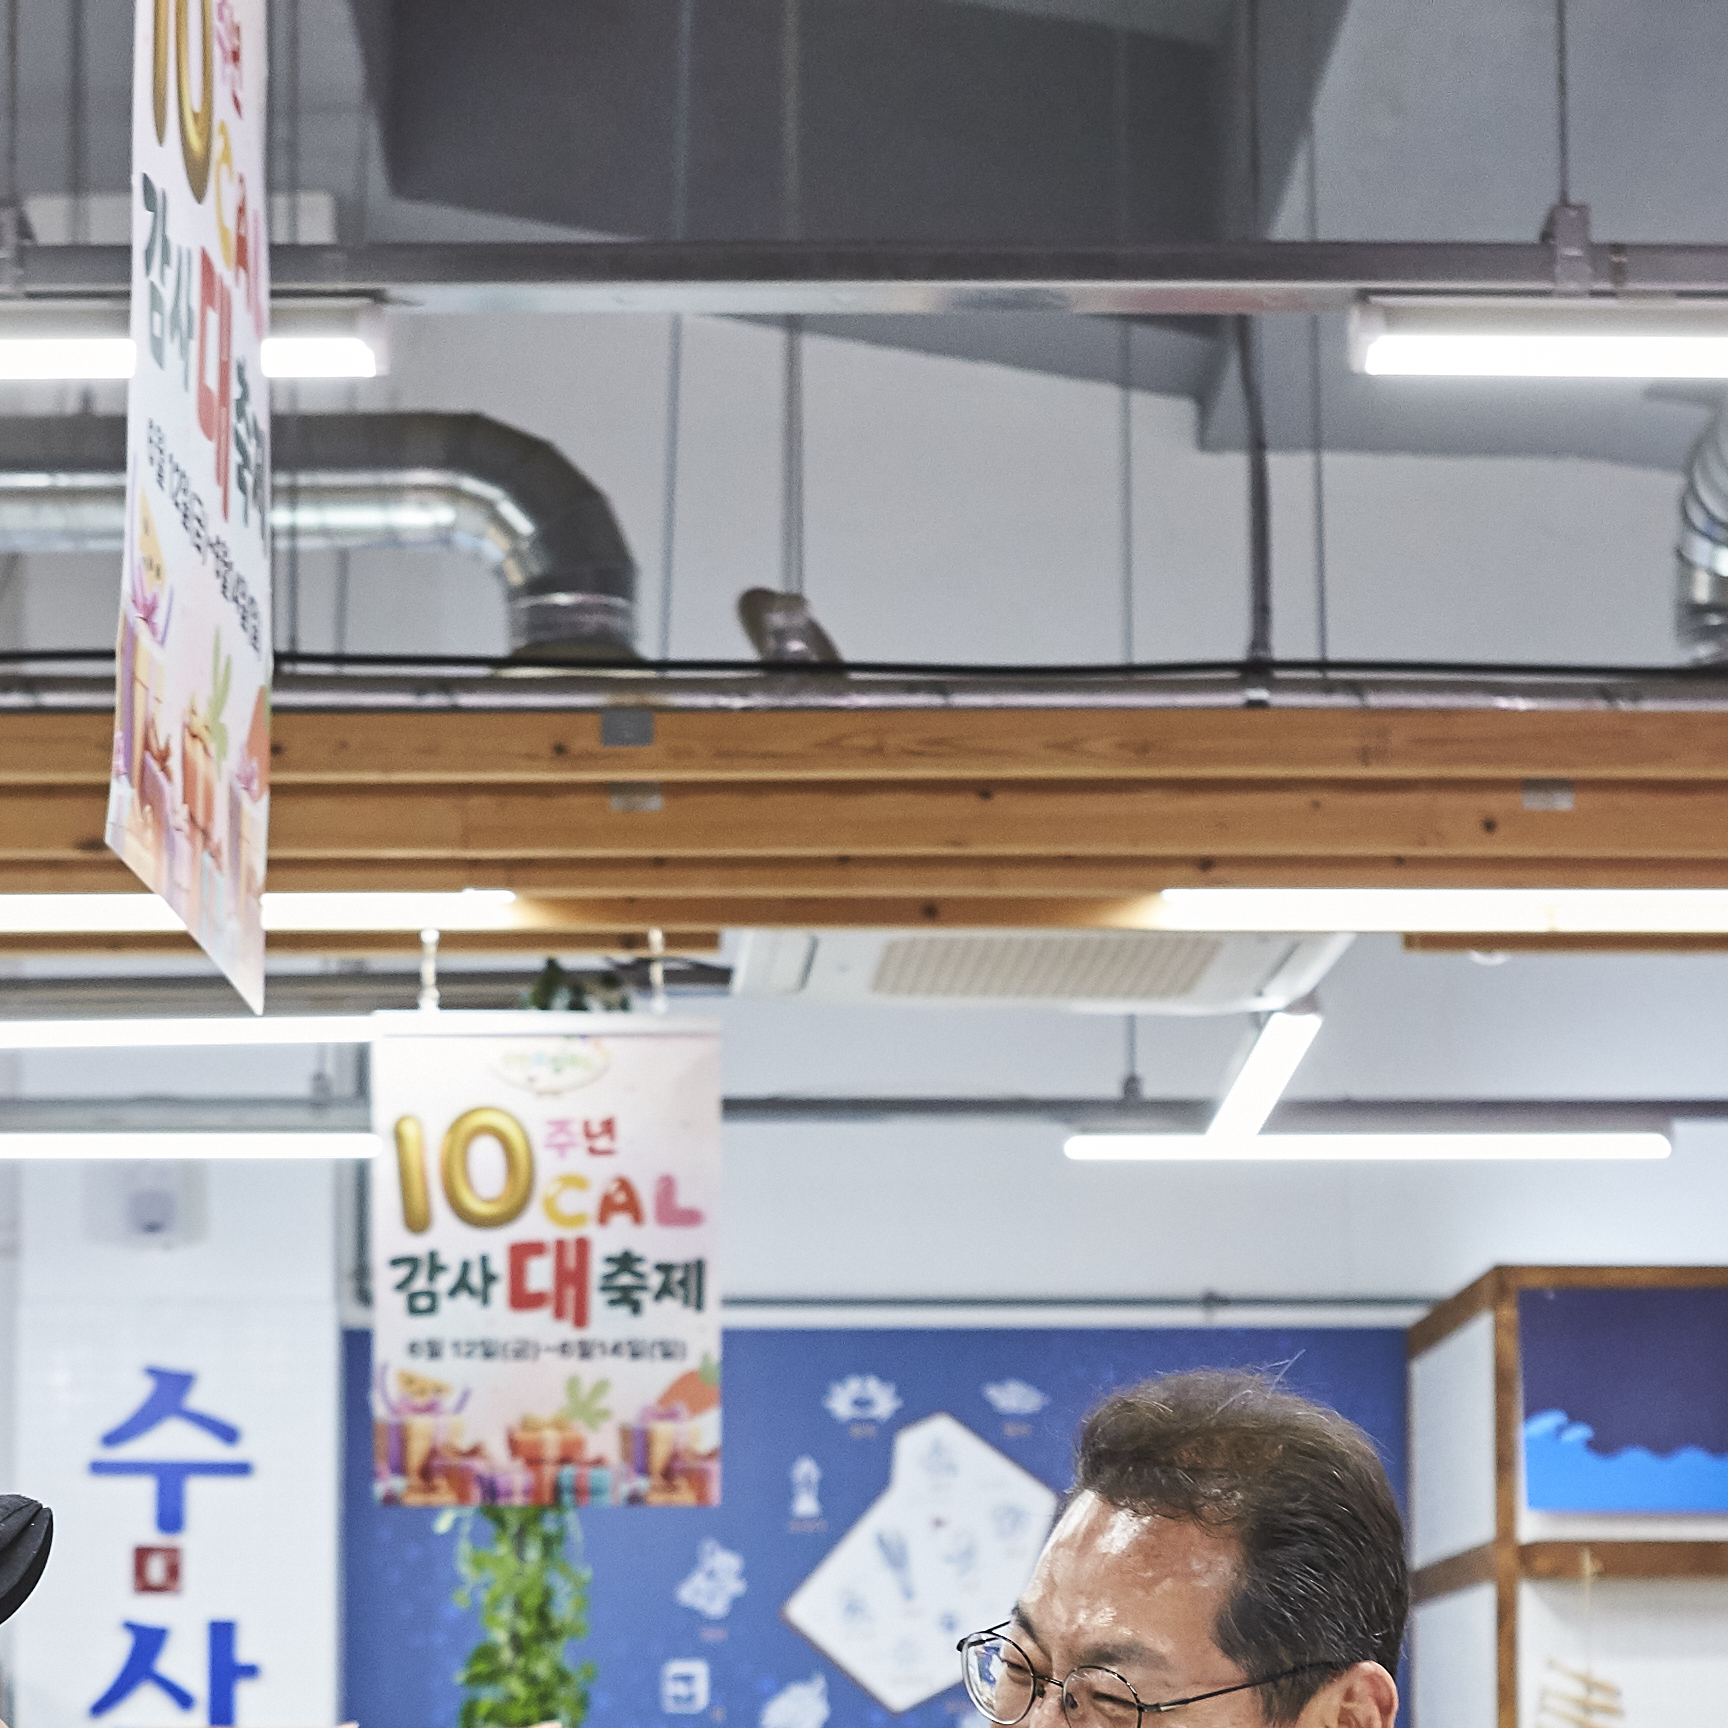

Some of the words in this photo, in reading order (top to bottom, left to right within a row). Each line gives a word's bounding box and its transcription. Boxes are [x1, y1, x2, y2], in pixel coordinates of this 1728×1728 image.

[394, 1106, 535, 1234] 10
[543, 1115, 618, 1158] 주년
[541, 1174, 706, 1229] CAL
